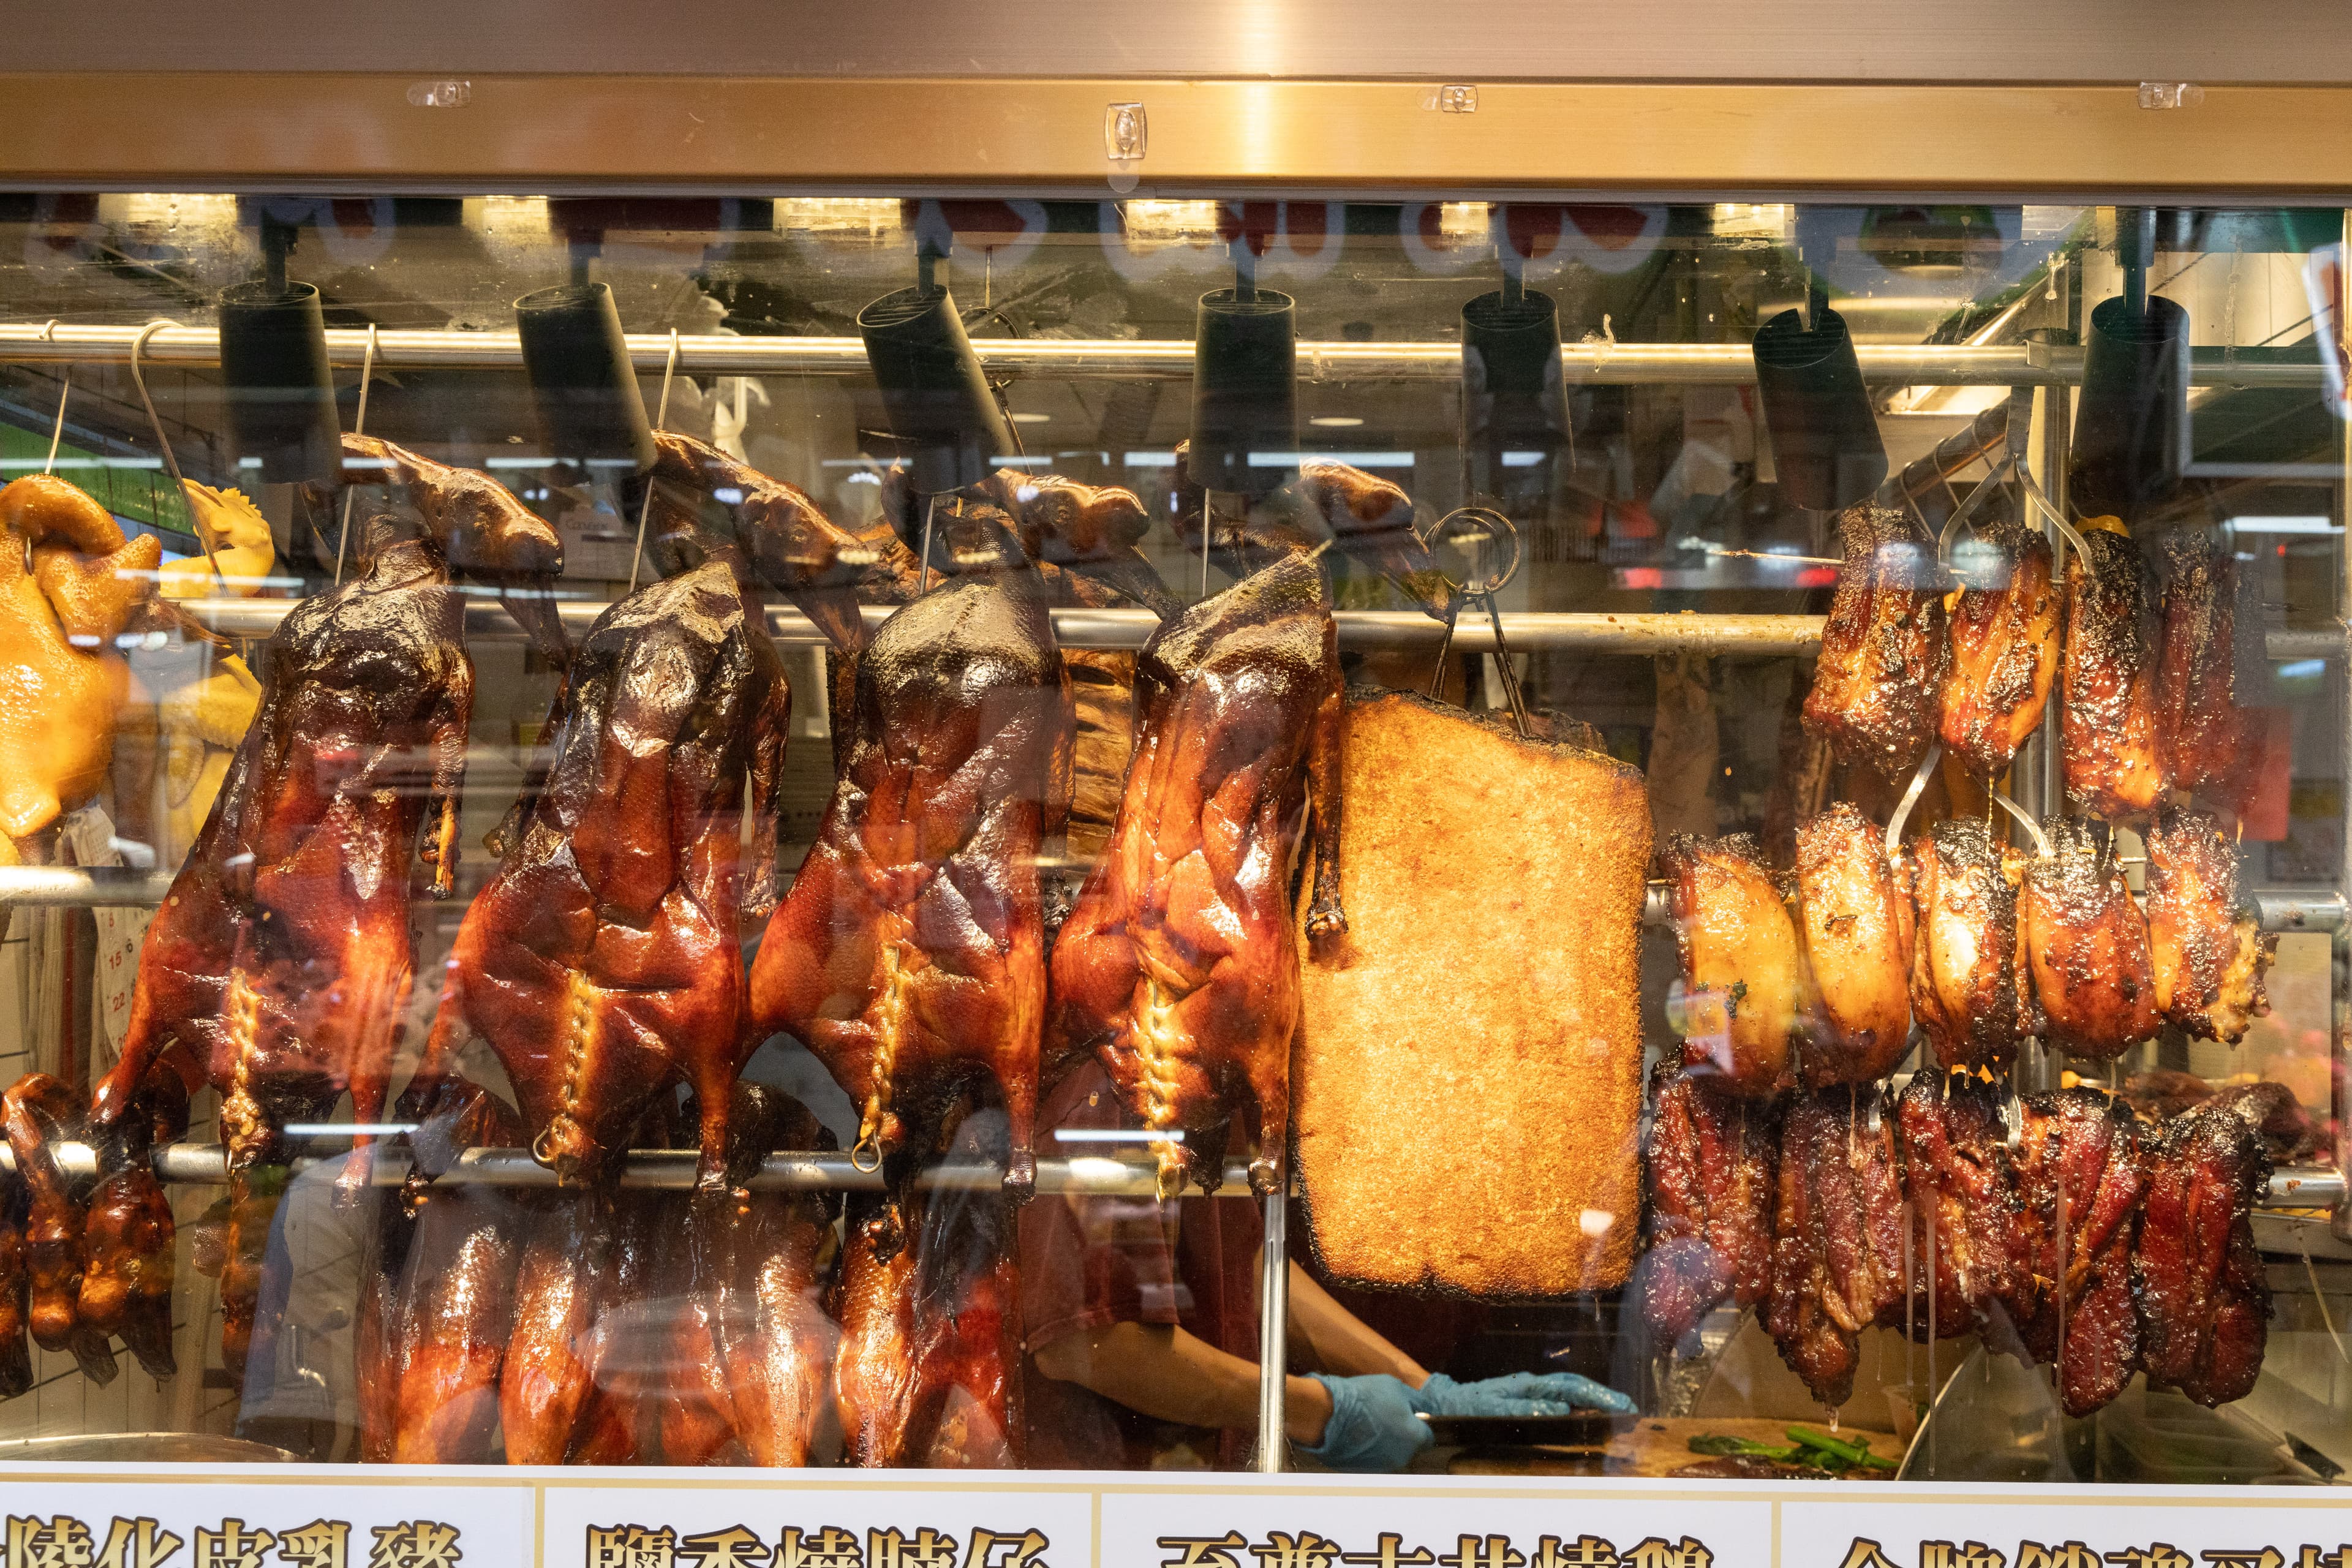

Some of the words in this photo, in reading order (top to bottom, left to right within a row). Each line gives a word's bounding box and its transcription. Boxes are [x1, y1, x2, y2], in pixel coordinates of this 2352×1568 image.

[109, 950, 122, 970] 15
[113, 992, 125, 1013] 22
[0, 1513, 463, 1568] 陵化皮乳豬
